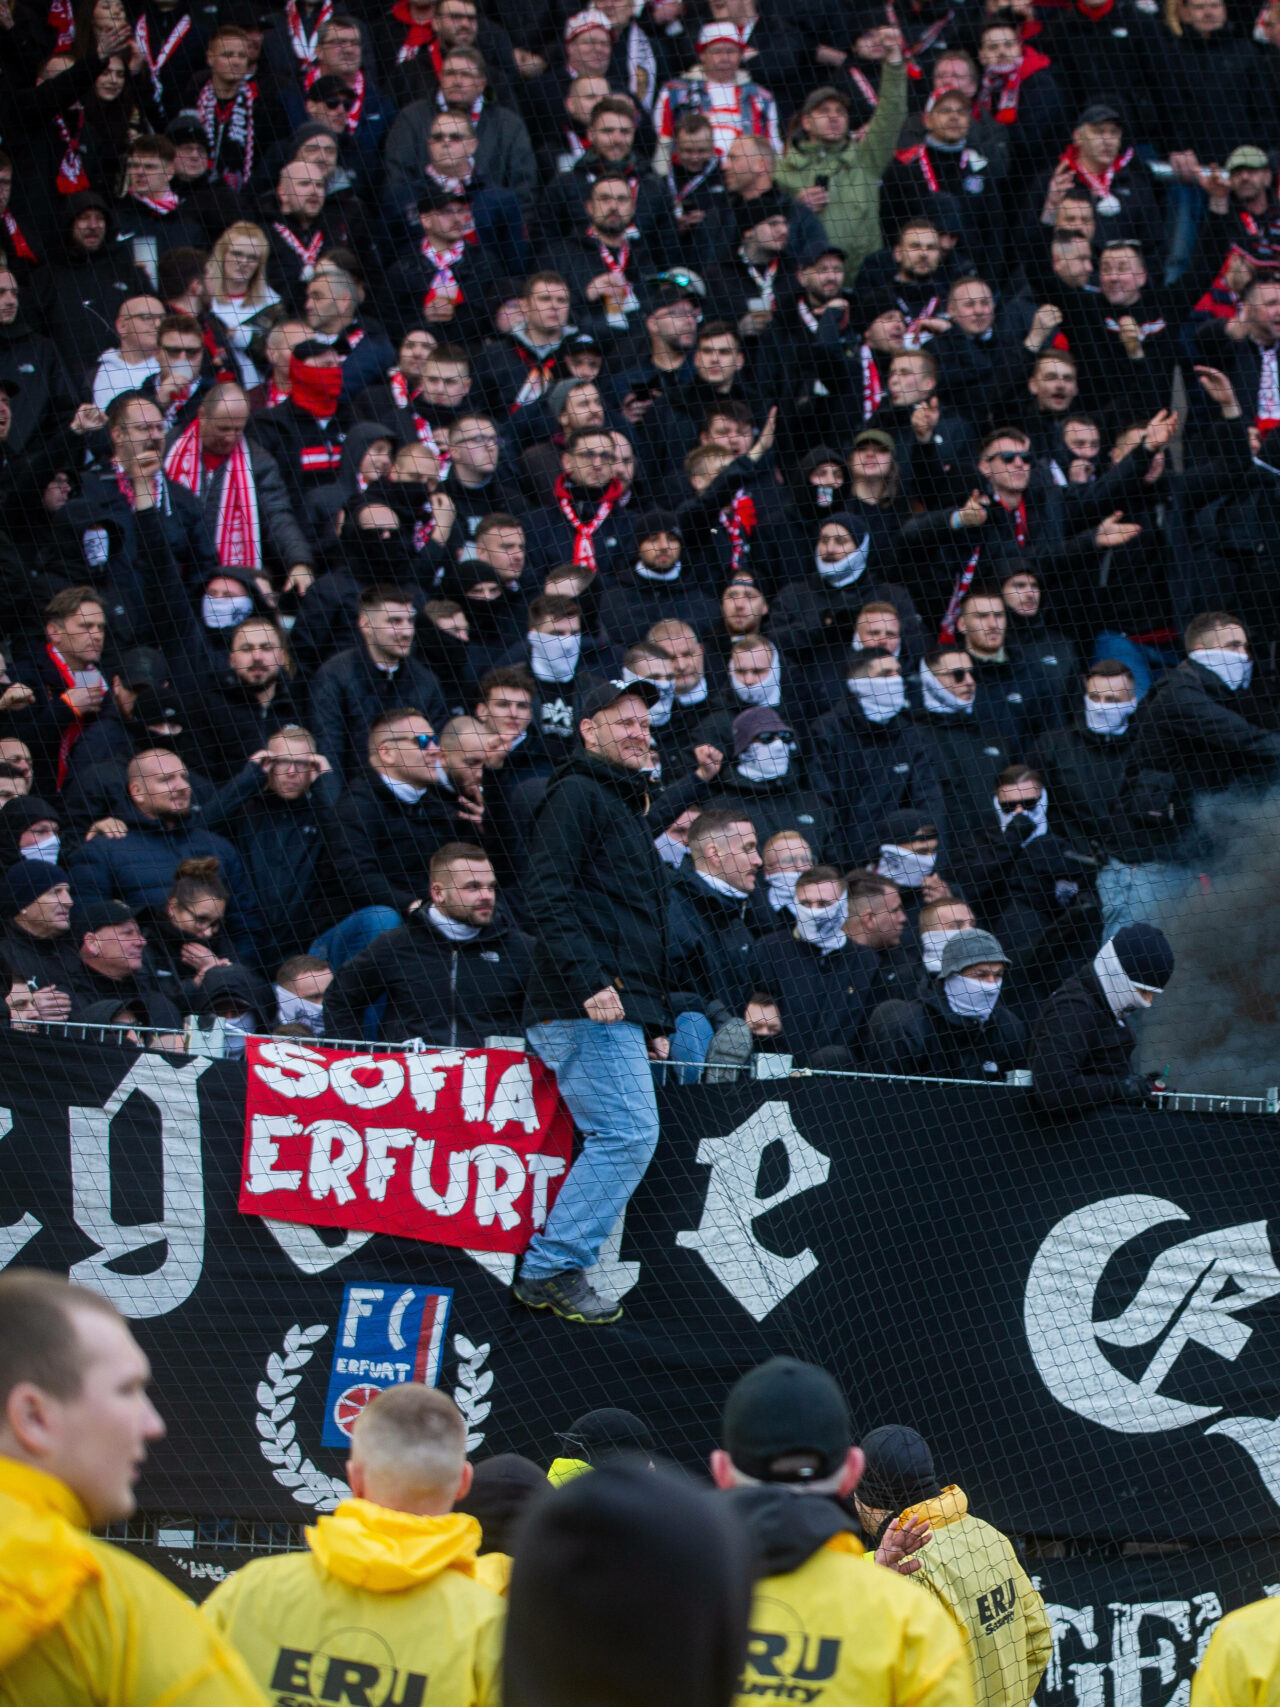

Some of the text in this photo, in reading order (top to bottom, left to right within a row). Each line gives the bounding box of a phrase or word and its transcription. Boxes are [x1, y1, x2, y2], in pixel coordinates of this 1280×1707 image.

[254, 1042, 540, 1134] SOFIA
[246, 1114, 566, 1231] ERFURT
[342, 1287, 416, 1351] FC
[336, 1357, 411, 1383] ERFURT
[746, 1632, 842, 1681] RU
